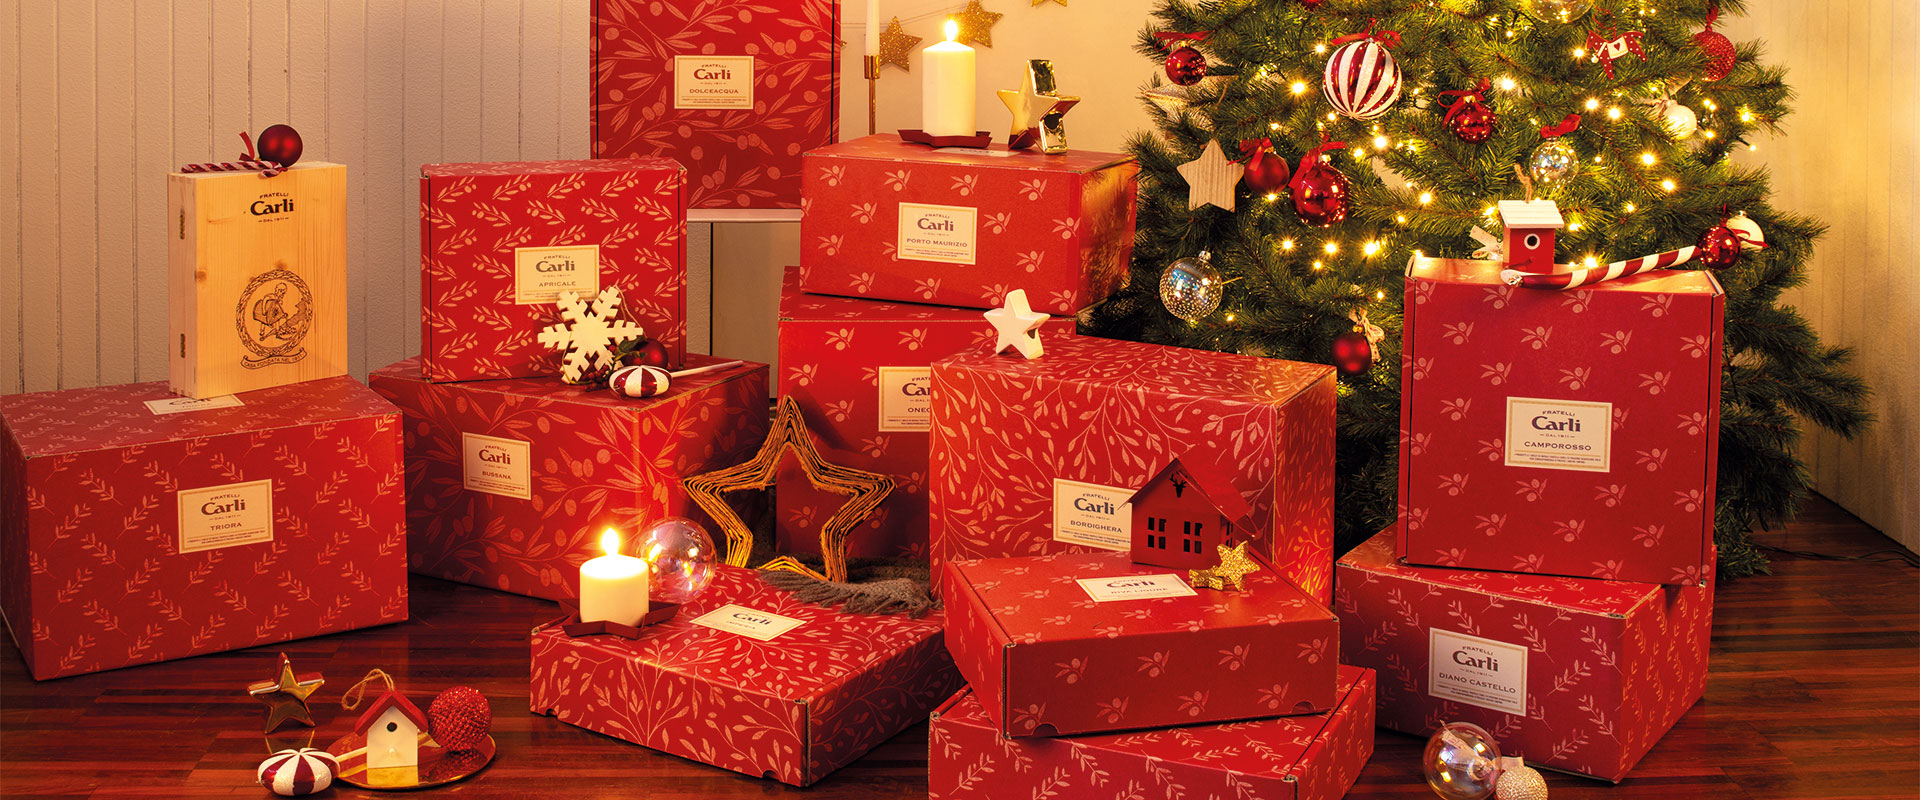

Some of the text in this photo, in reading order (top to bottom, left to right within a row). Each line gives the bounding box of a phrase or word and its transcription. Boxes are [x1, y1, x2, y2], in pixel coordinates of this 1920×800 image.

[693, 68, 731, 80] Carli
[250, 198, 294, 216] Carli
[917, 217, 954, 232] Carli
[933, 240, 968, 248] MAURIZIO
[535, 260, 575, 273] Carli
[902, 382, 931, 396] Ca
[1531, 415, 1581, 432] Carli
[1524, 441, 1592, 451] CAMPOROSSO
[478, 449, 511, 465] Carli
[482, 470, 512, 480] BUSSANA
[1082, 493, 1111, 501] FRATELLI
[201, 499, 246, 516] Carli
[1074, 497, 1115, 515] Carli
[210, 522, 243, 531] TRIORA
[1070, 520, 1123, 533] BORDIGHERA
[1106, 580, 1156, 588] Carli
[1462, 645, 1494, 656] FRATELLI
[1452, 650, 1499, 672] Carli
[1439, 672, 1516, 694] DIANO CASTELLO
